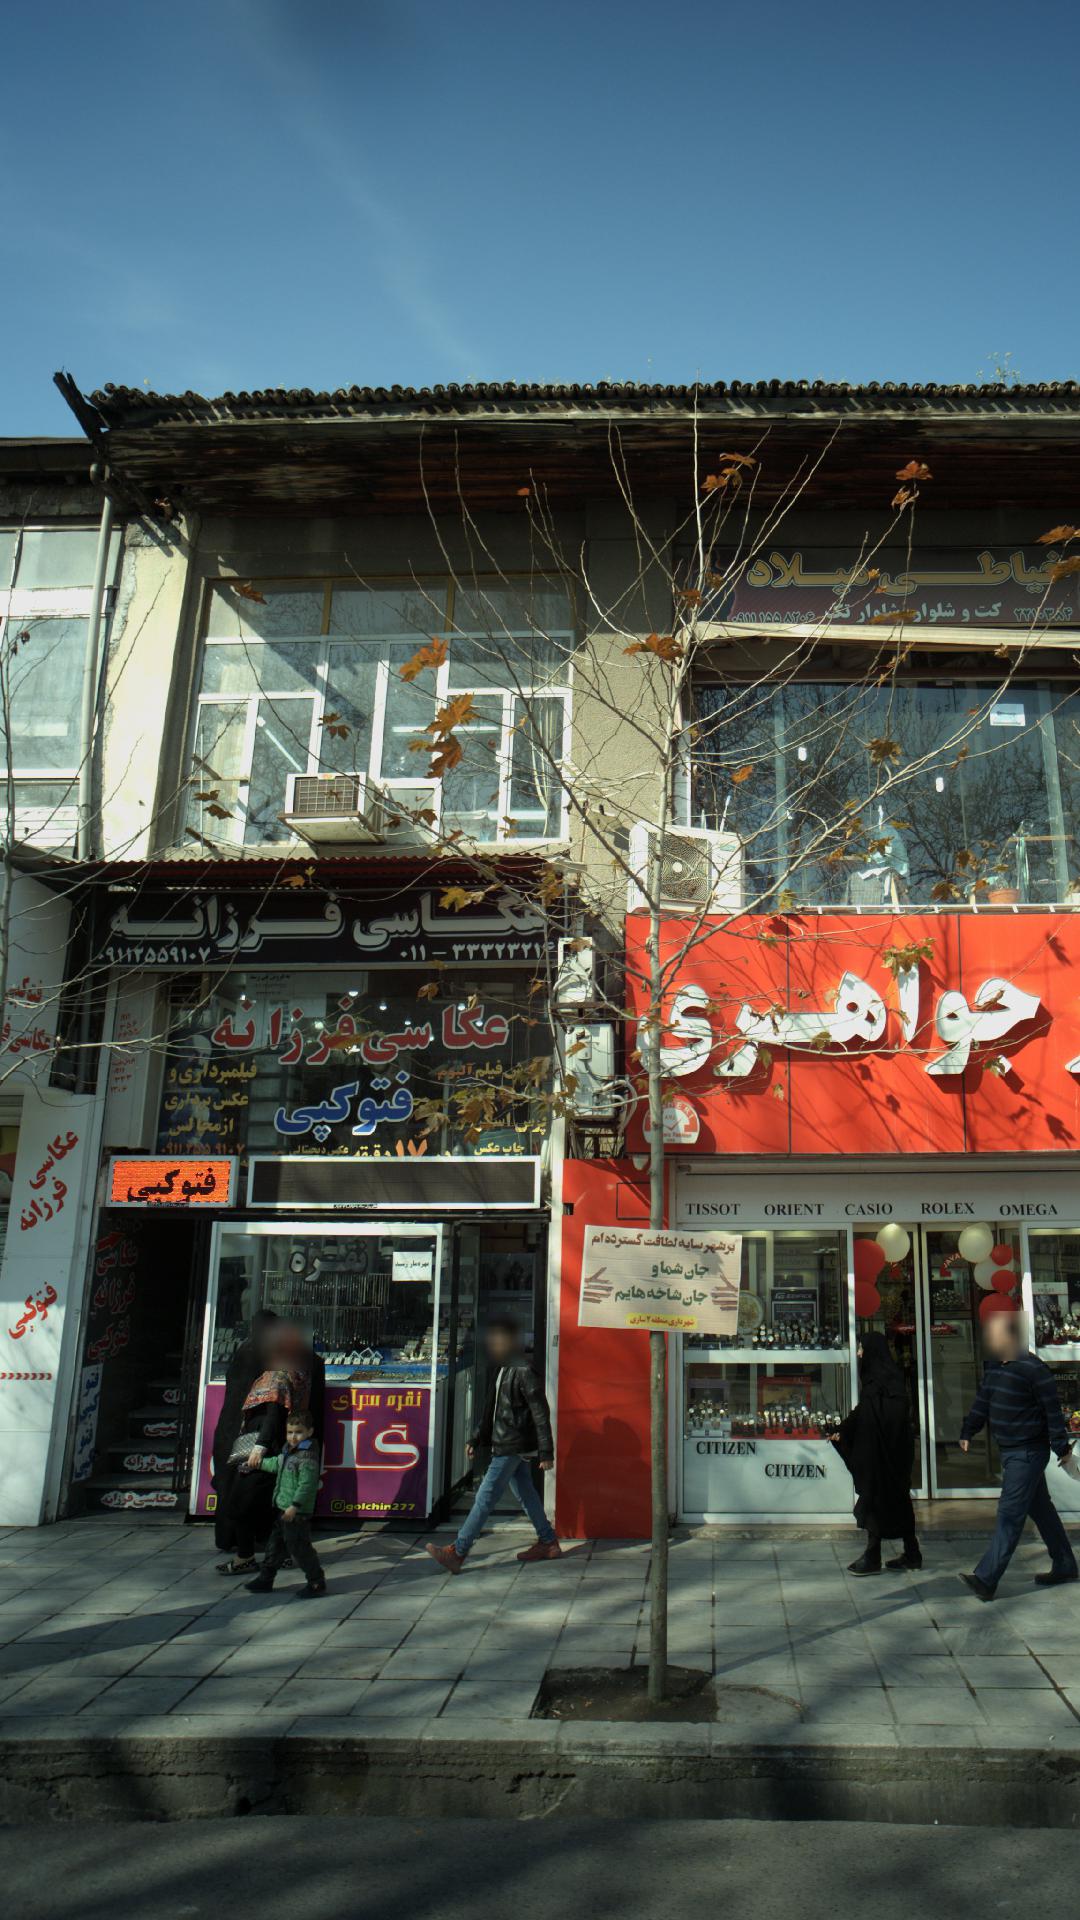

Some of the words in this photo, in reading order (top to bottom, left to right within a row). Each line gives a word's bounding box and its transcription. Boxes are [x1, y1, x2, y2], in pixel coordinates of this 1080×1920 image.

[747, 551, 873, 595] میلاد
[914, 601, 956, 623] شلوار
[961, 608, 971, 623] و
[974, 601, 1002, 618] کت
[109, 895, 346, 953] فرزانه
[353, 891, 547, 951] عکاسی
[636, 963, 1041, 1078] جواهری
[211, 997, 359, 1065] فرزانه
[361, 1005, 510, 1064] عکاسی
[168, 1066, 177, 1083] و
[212, 1092, 249, 1111] عکس
[274, 1071, 414, 1142] فتوکپی
[474, 1142, 501, 1156] عکس
[29, 1131, 79, 1190] عکاسی
[127, 1167, 217, 1202] فتوکپی
[20, 1176, 68, 1231] فرزانه
[685, 1203, 741, 1216] TISSOT
[764, 1203, 825, 1216] ORIENT
[844, 1202, 893, 1216] CASIO
[920, 1202, 975, 1216] ROLEX
[999, 1203, 1058, 1217] OMEGA
[703, 1240, 725, 1254] شهر
[725, 1241, 736, 1255] بر
[651, 1266, 660, 1277] و
[660, 1261, 683, 1275] شما
[685, 1263, 709, 1280] جان
[647, 1286, 682, 1300] شاخه
[682, 1288, 708, 1306] جان
[8, 1282, 58, 1340] فتوکپی
[331, 1388, 380, 1411] سرای
[386, 1390, 422, 1411] نقره
[696, 1441, 757, 1455] CITIZEN
[764, 1463, 826, 1478] CITIZEN
[344, 1502, 416, 1513] golchin277
